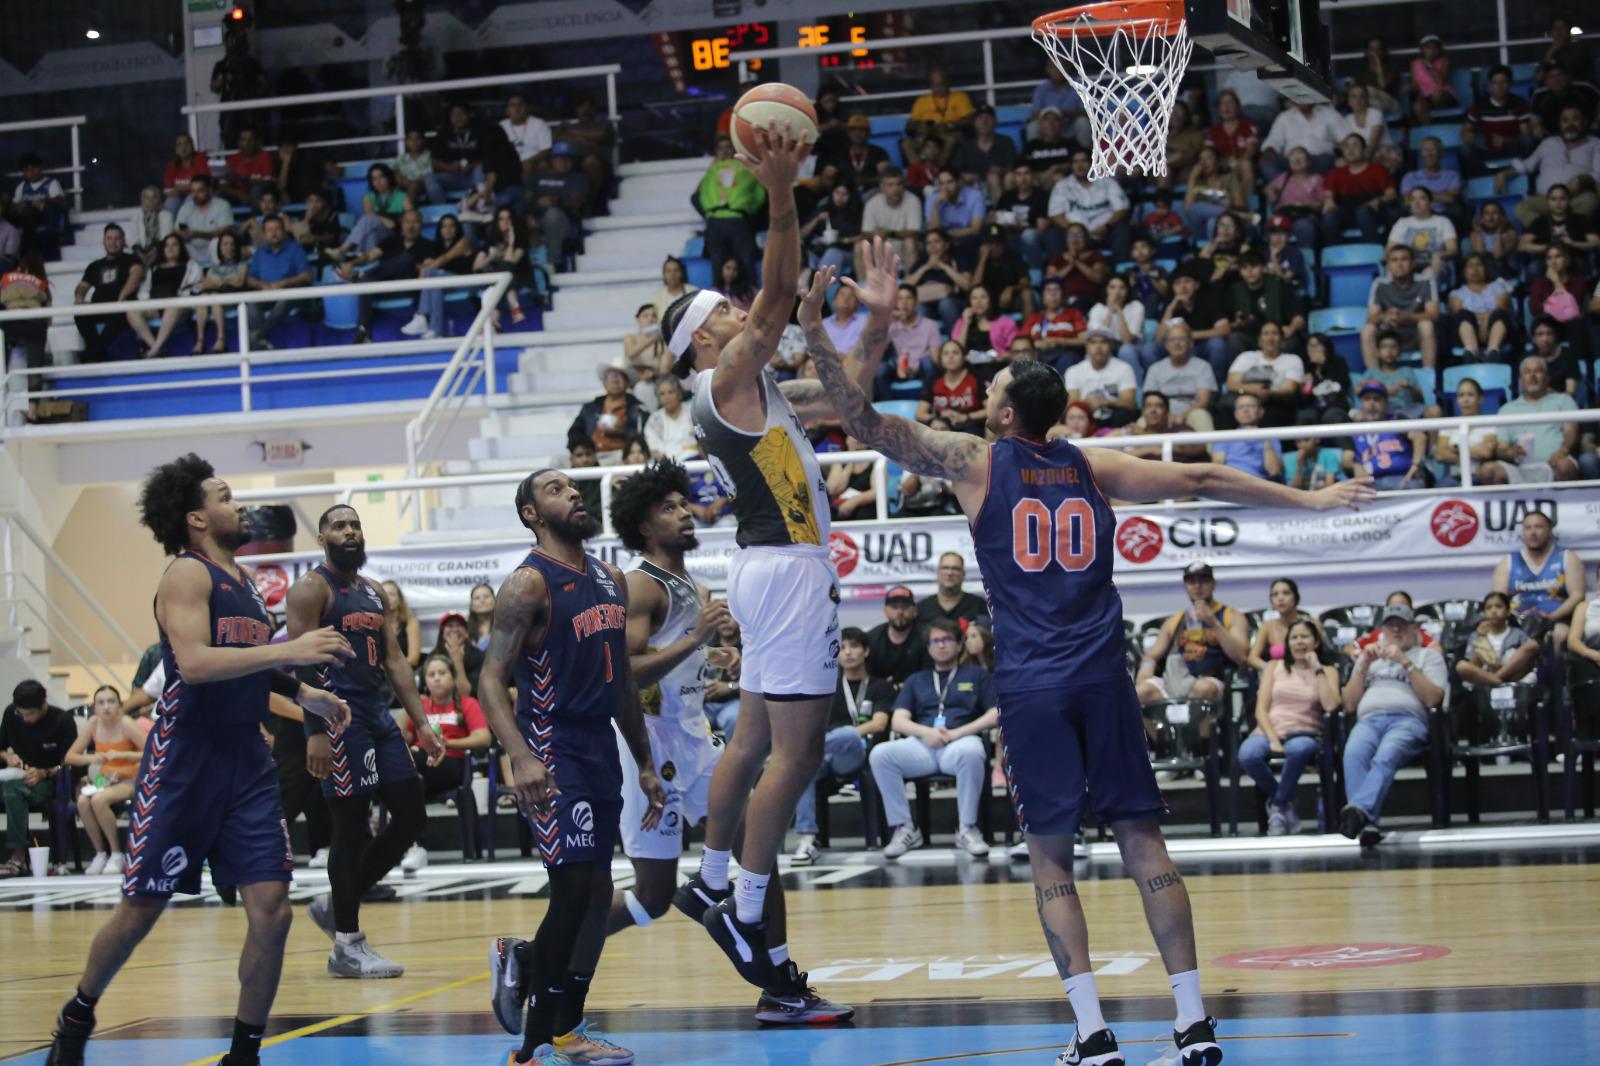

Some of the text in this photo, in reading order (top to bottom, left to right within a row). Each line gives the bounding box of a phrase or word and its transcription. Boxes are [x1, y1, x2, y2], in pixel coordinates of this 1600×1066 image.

[1332, 513, 1401, 527] GRANDES
[1012, 497, 1096, 572] 00
[1169, 517, 1239, 548] CID
[1342, 529, 1392, 543] LOBOS
[864, 532, 932, 563] UAD
[437, 559, 499, 572] GRANDES
[446, 574, 490, 586] LOBOS
